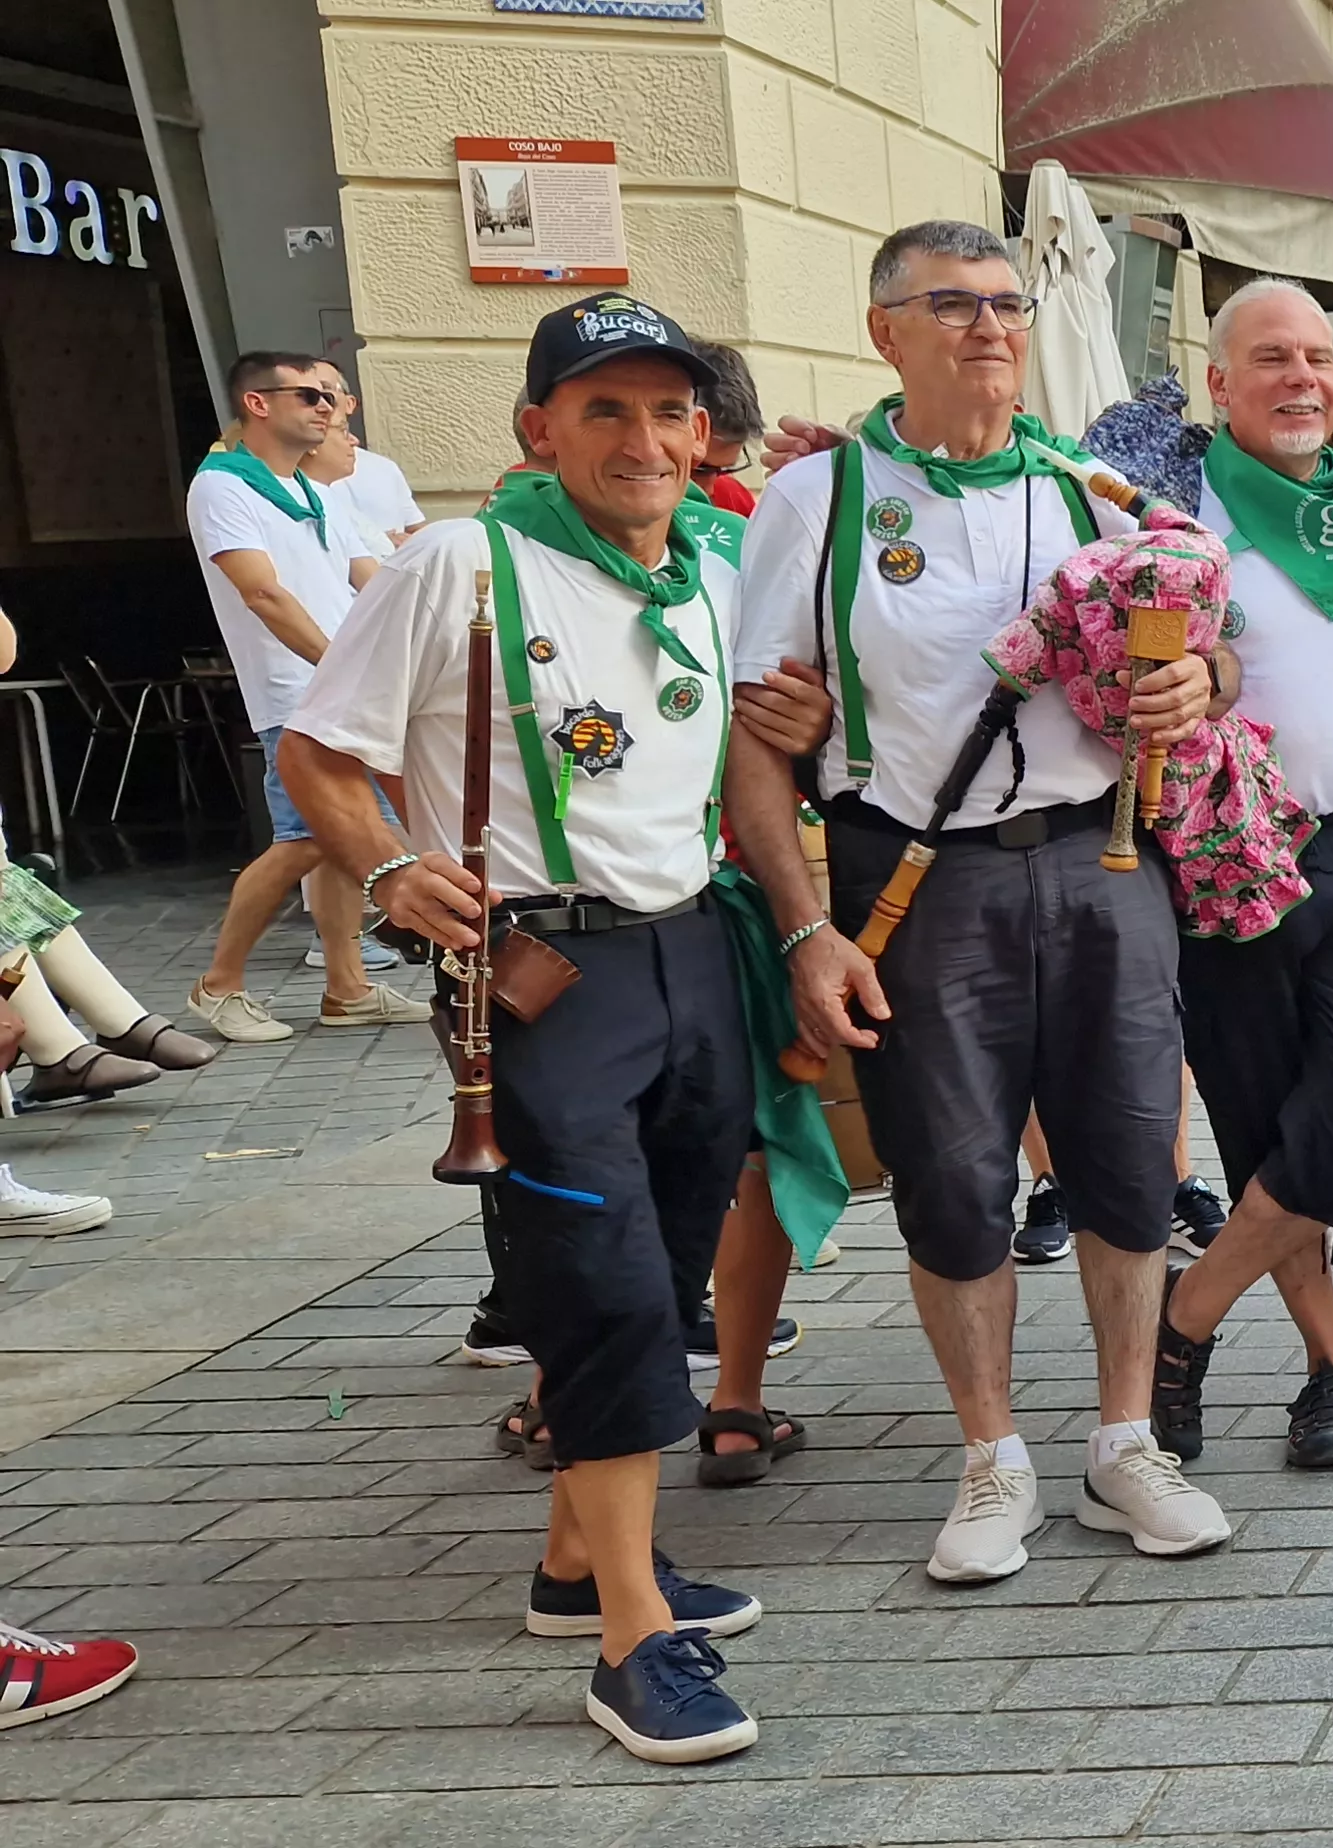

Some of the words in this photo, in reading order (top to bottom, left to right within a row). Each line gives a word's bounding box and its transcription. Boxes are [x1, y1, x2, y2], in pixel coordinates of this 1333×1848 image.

[508, 141, 535, 151] COSO
[537, 142, 562, 152] BAJO
[0, 148, 158, 269] Bar
[560, 706, 596, 736] bucardo
